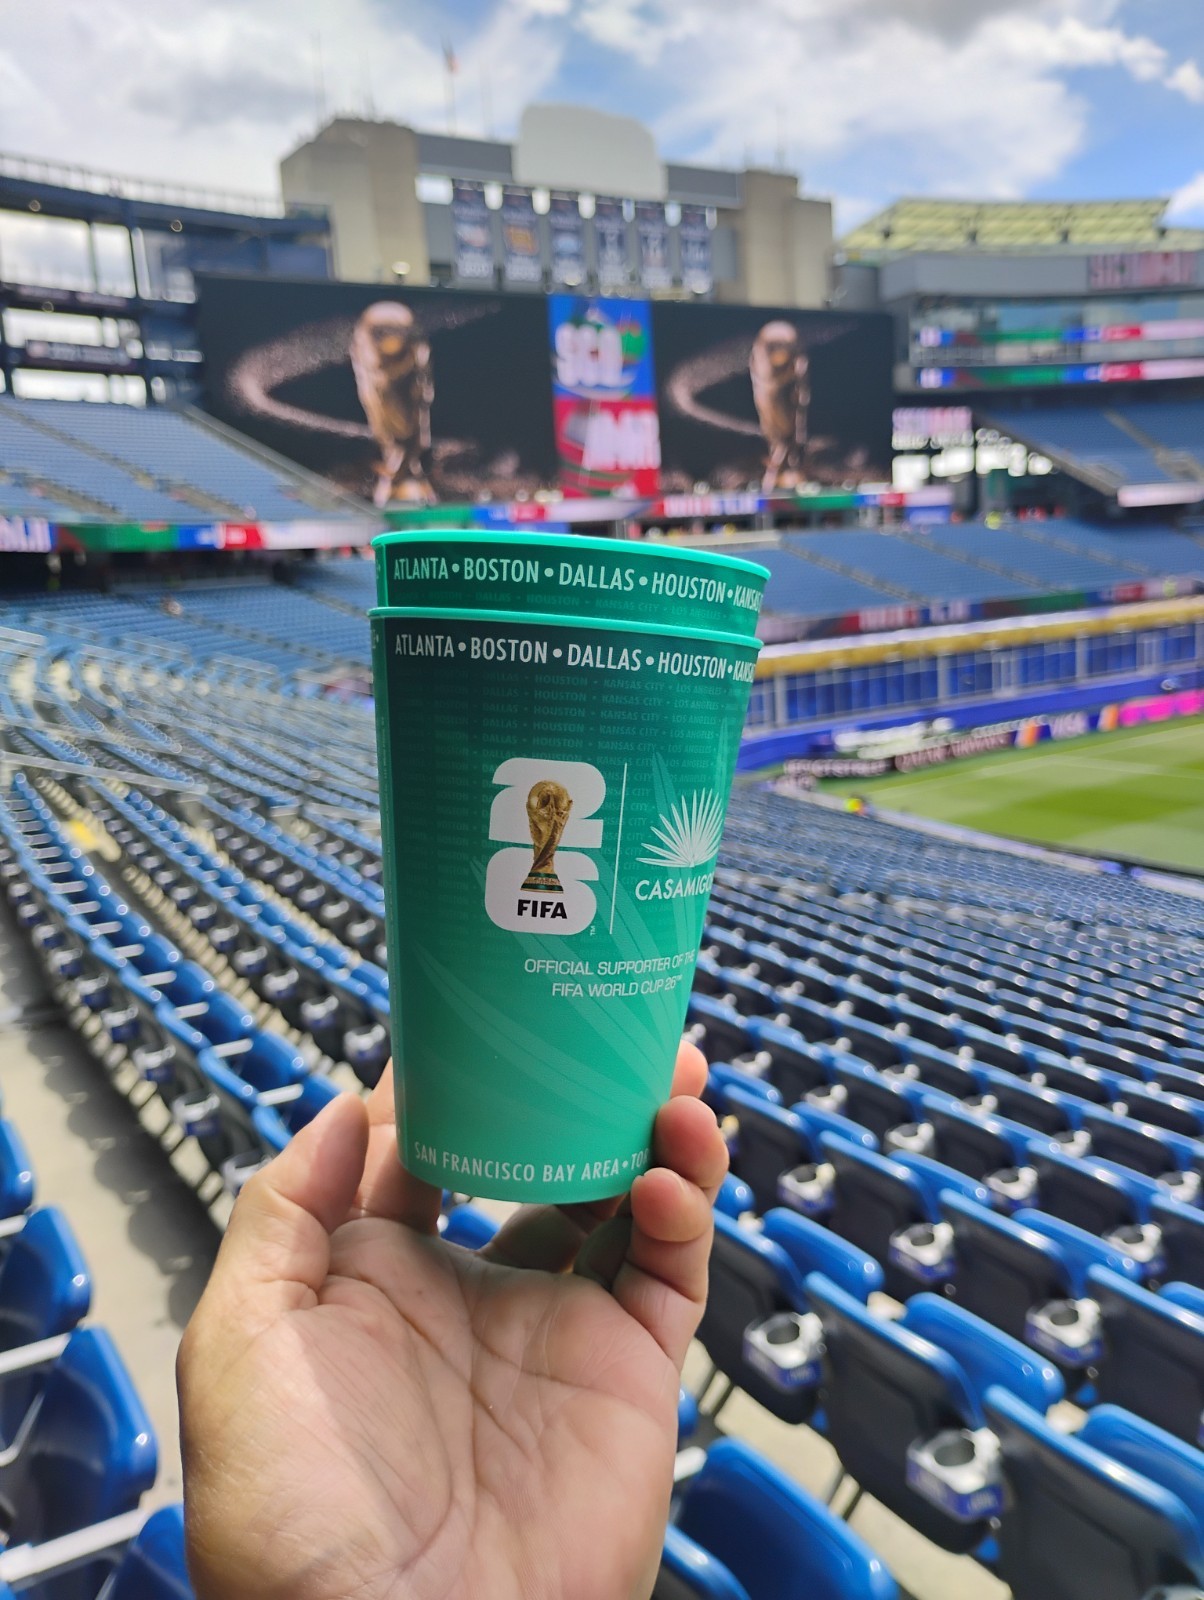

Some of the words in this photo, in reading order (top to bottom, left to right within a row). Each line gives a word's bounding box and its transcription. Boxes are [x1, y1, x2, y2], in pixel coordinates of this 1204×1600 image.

[394, 557, 449, 580] ATLANTA
[463, 557, 539, 584] BOSTON
[559, 562, 635, 592] DALLAS
[651, 571, 727, 604] HOUSTON
[395, 634, 455, 658] ATLANTA
[470, 636, 548, 664] BOSTON
[567, 643, 642, 672] DALLAS
[657, 651, 728, 679] HOUSTON
[535, 675, 588, 686] HOUSTON
[604, 679, 641, 690] KANSAS
[645, 682, 664, 691] CITY
[482, 687, 519, 697] DALLAS
[534, 690, 586, 701] HOUSTON
[602, 695, 639, 705] KANSAS
[643, 697, 662, 706] CITY
[482, 703, 518, 713] DALLAS
[534, 705, 585, 717] HOUSTON
[601, 710, 637, 721] KANSAS
[642, 712, 660, 722] CITY
[482, 718, 518, 728] DALLAS
[533, 721, 584, 733] HOUSTON
[599, 725, 636, 736] KANSAS
[639, 727, 658, 737] CITY
[532, 736, 583, 748] HOUSTON
[598, 741, 634, 752] KANSAS
[516, 898, 568, 920] FIFA
[523, 958, 594, 976] OFFICIAL
[597, 955, 670, 977] SUPPORTER
[671, 953, 685, 969] OF
[551, 982, 584, 998] FIFA
[587, 981, 639, 998] WORLD
[640, 978, 664, 995] CUP
[413, 1143, 437, 1166] SAN
[442, 1151, 535, 1182] FRANCISCO
[542, 1164, 576, 1183] BAY
[580, 1157, 620, 1181] AREA
